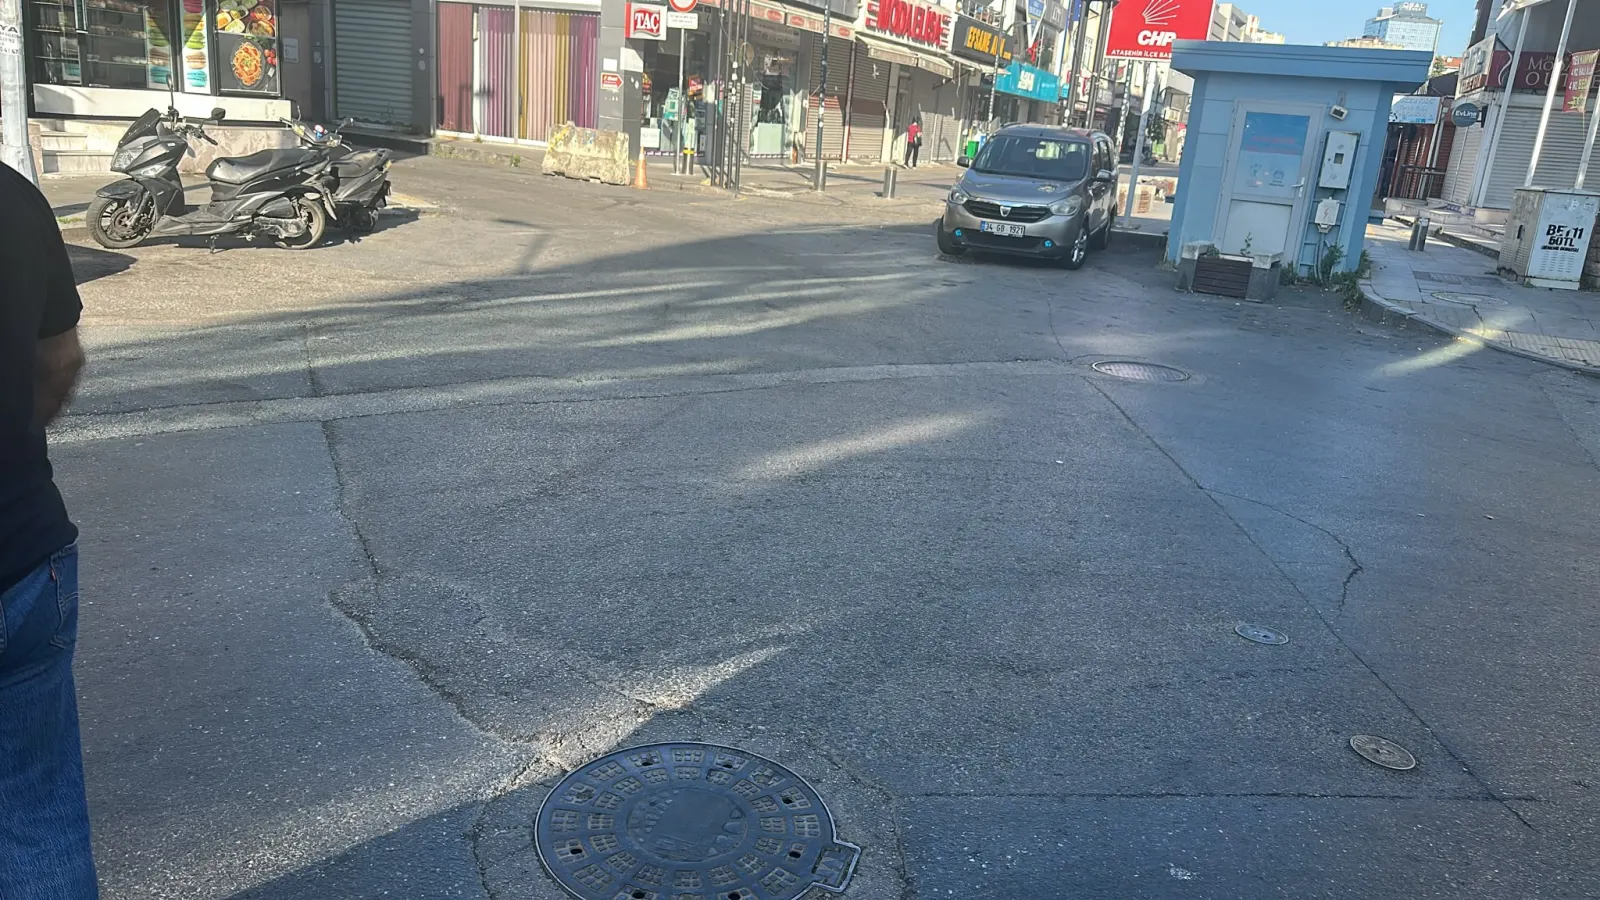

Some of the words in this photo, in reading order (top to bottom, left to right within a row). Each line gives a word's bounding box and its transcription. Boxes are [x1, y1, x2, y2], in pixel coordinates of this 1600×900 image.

[635, 12, 660, 34] TAÇ
[1137, 30, 1177, 47] CHP
[1144, 50, 1158, 58] İLÇE
[1009, 225, 1024, 234] 1921
